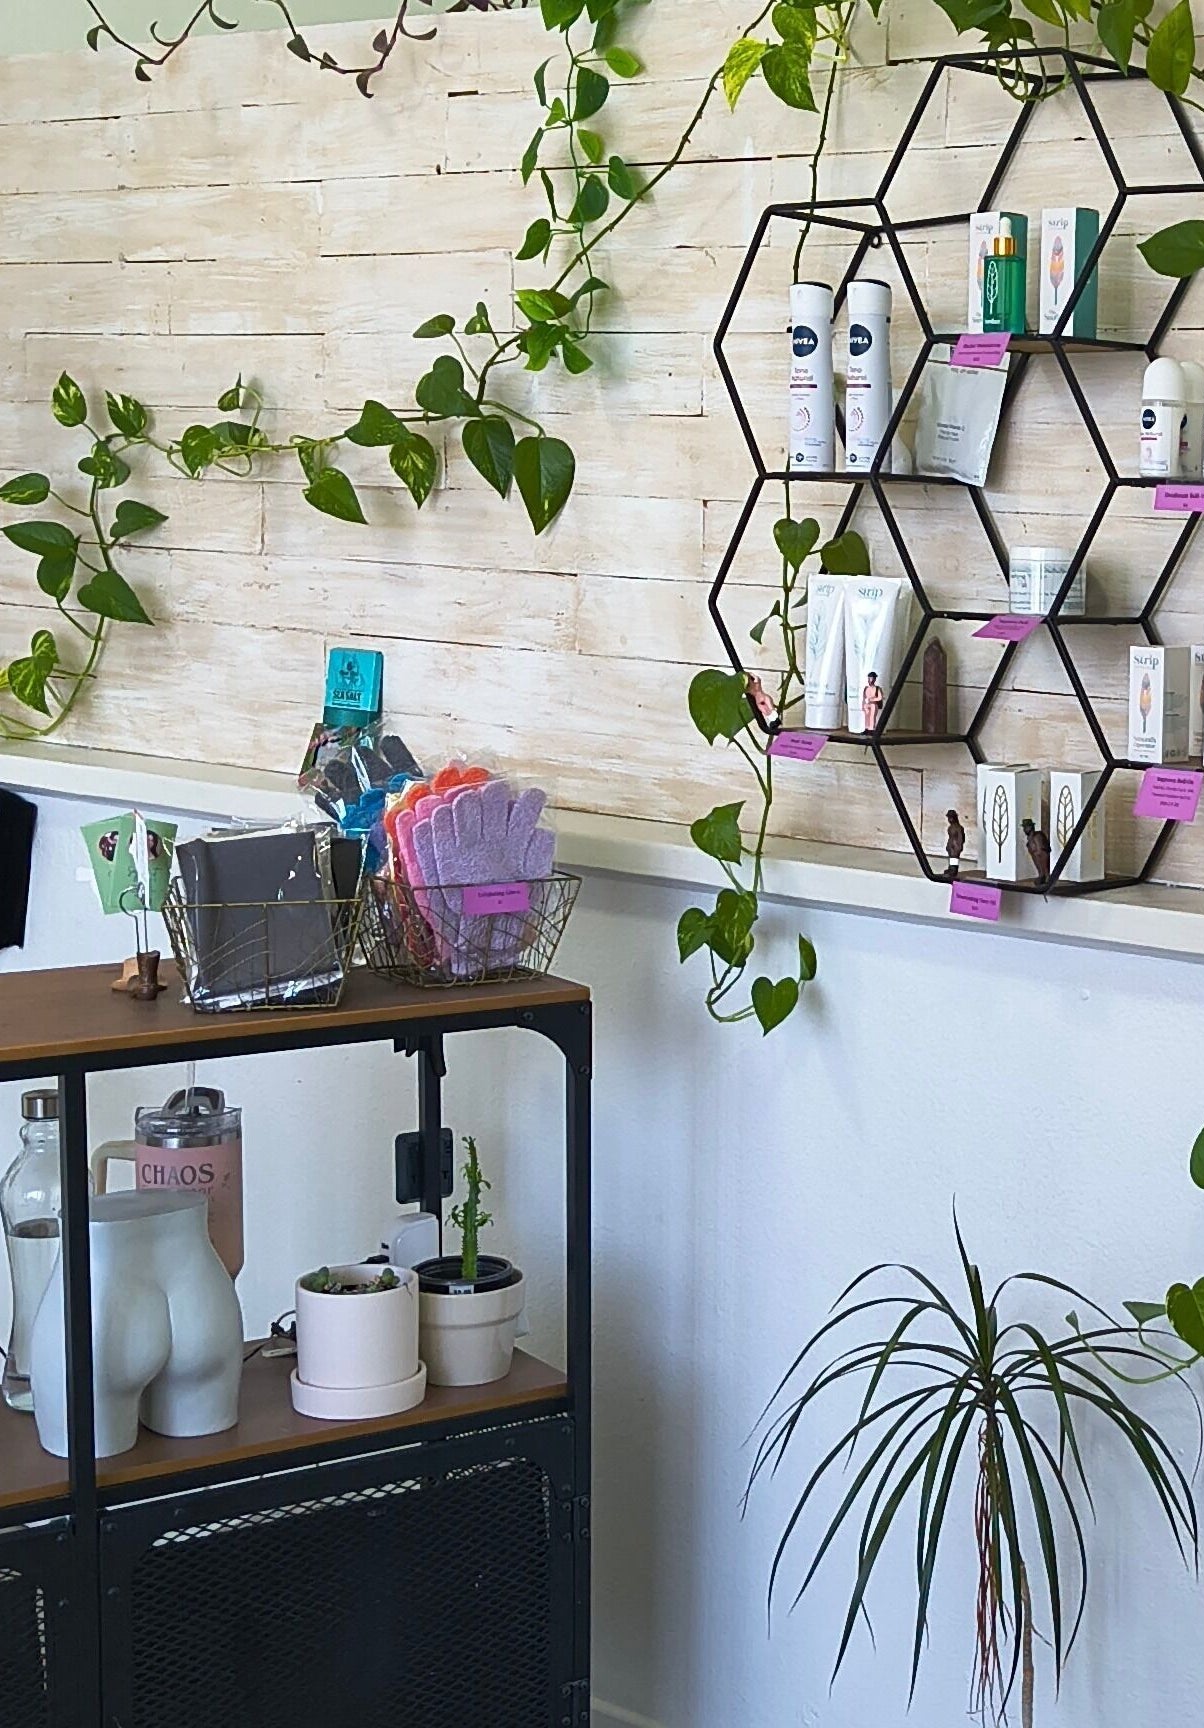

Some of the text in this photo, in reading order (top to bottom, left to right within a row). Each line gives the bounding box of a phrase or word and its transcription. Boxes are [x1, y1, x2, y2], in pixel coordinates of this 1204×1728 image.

[332, 688, 362, 702] SEA SALT
[141, 1163, 214, 1185] CHAOS
